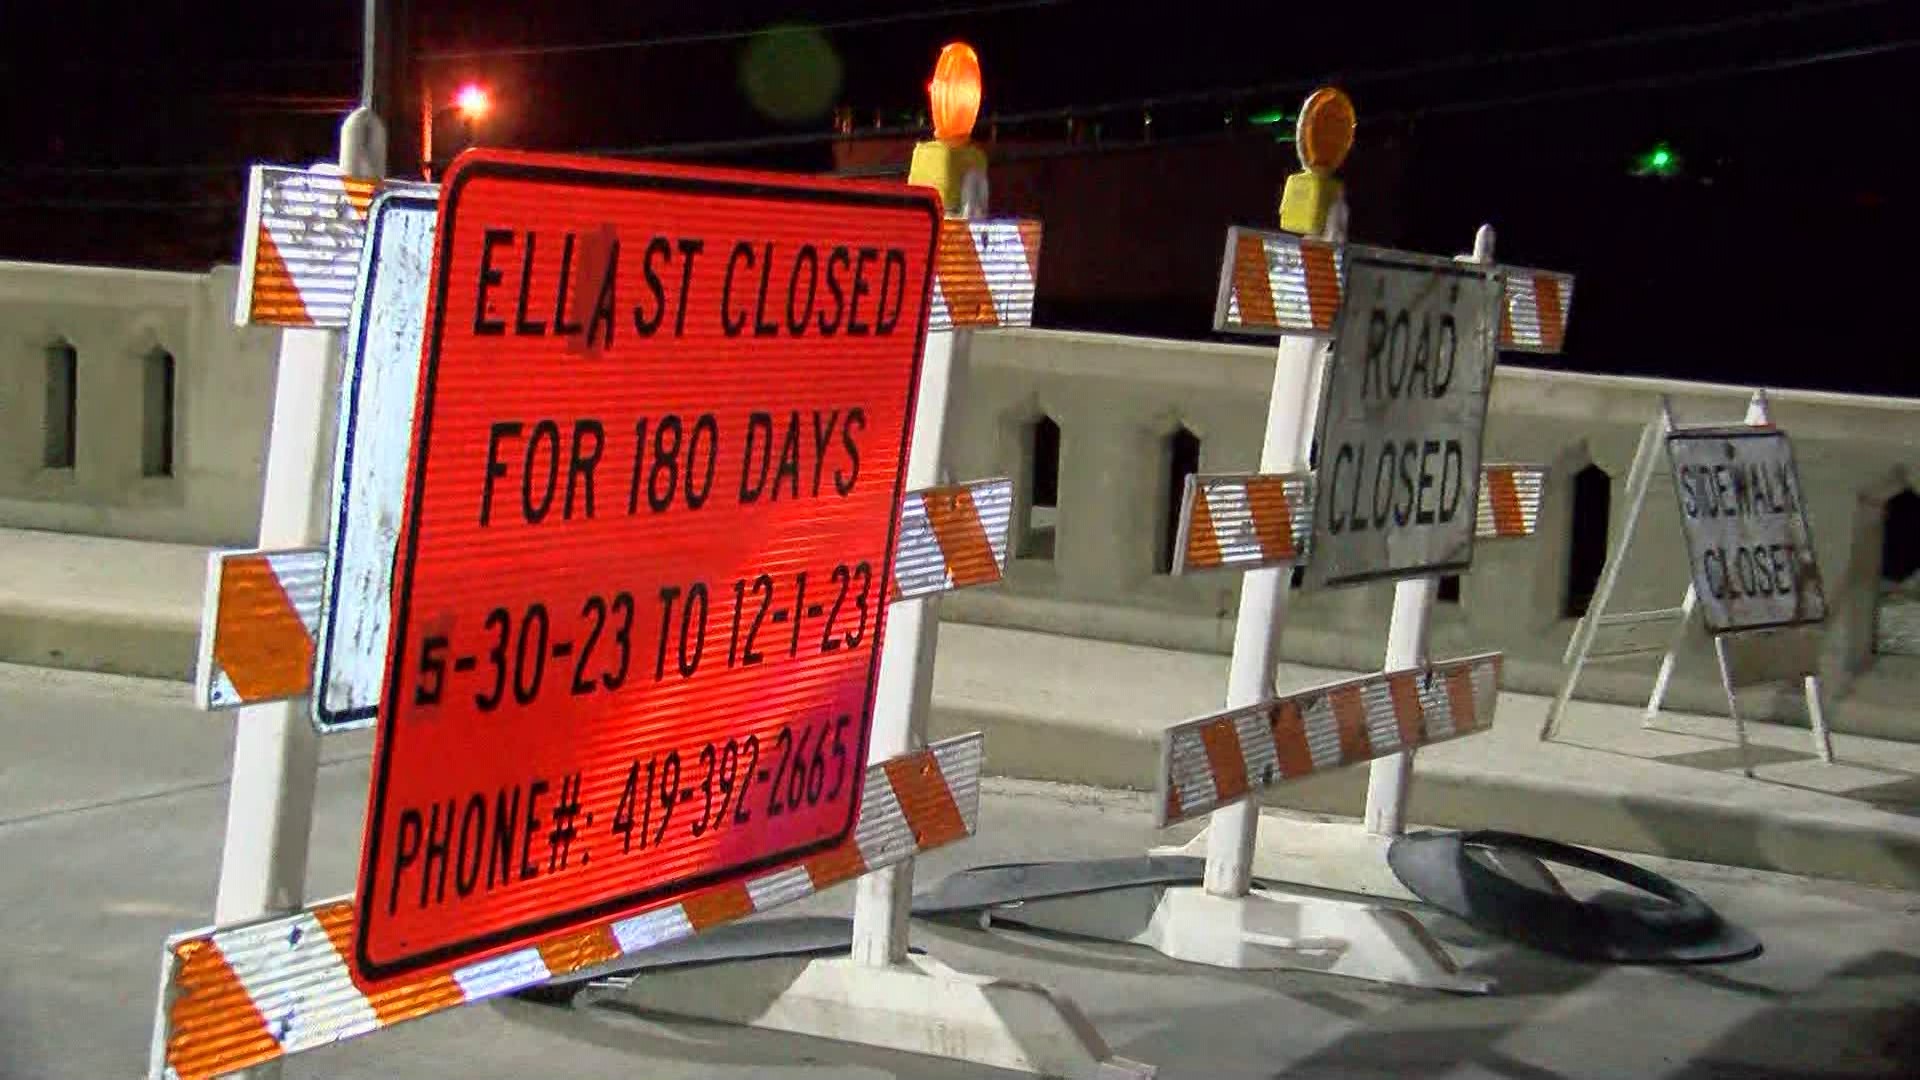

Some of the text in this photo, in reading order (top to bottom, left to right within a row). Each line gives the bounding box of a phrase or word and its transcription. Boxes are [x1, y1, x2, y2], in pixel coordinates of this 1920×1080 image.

[633, 237, 704, 338] ST
[721, 241, 906, 338] CLOSED
[1363, 306, 1457, 398] ROAD
[480, 406, 866, 528] FOR 180 DAYS
[1329, 439, 1463, 536] CLOSED
[415, 562, 872, 712] 5-30-23 TO 12-1-23
[388, 716, 851, 916] PHONE#: 419-392-2665
